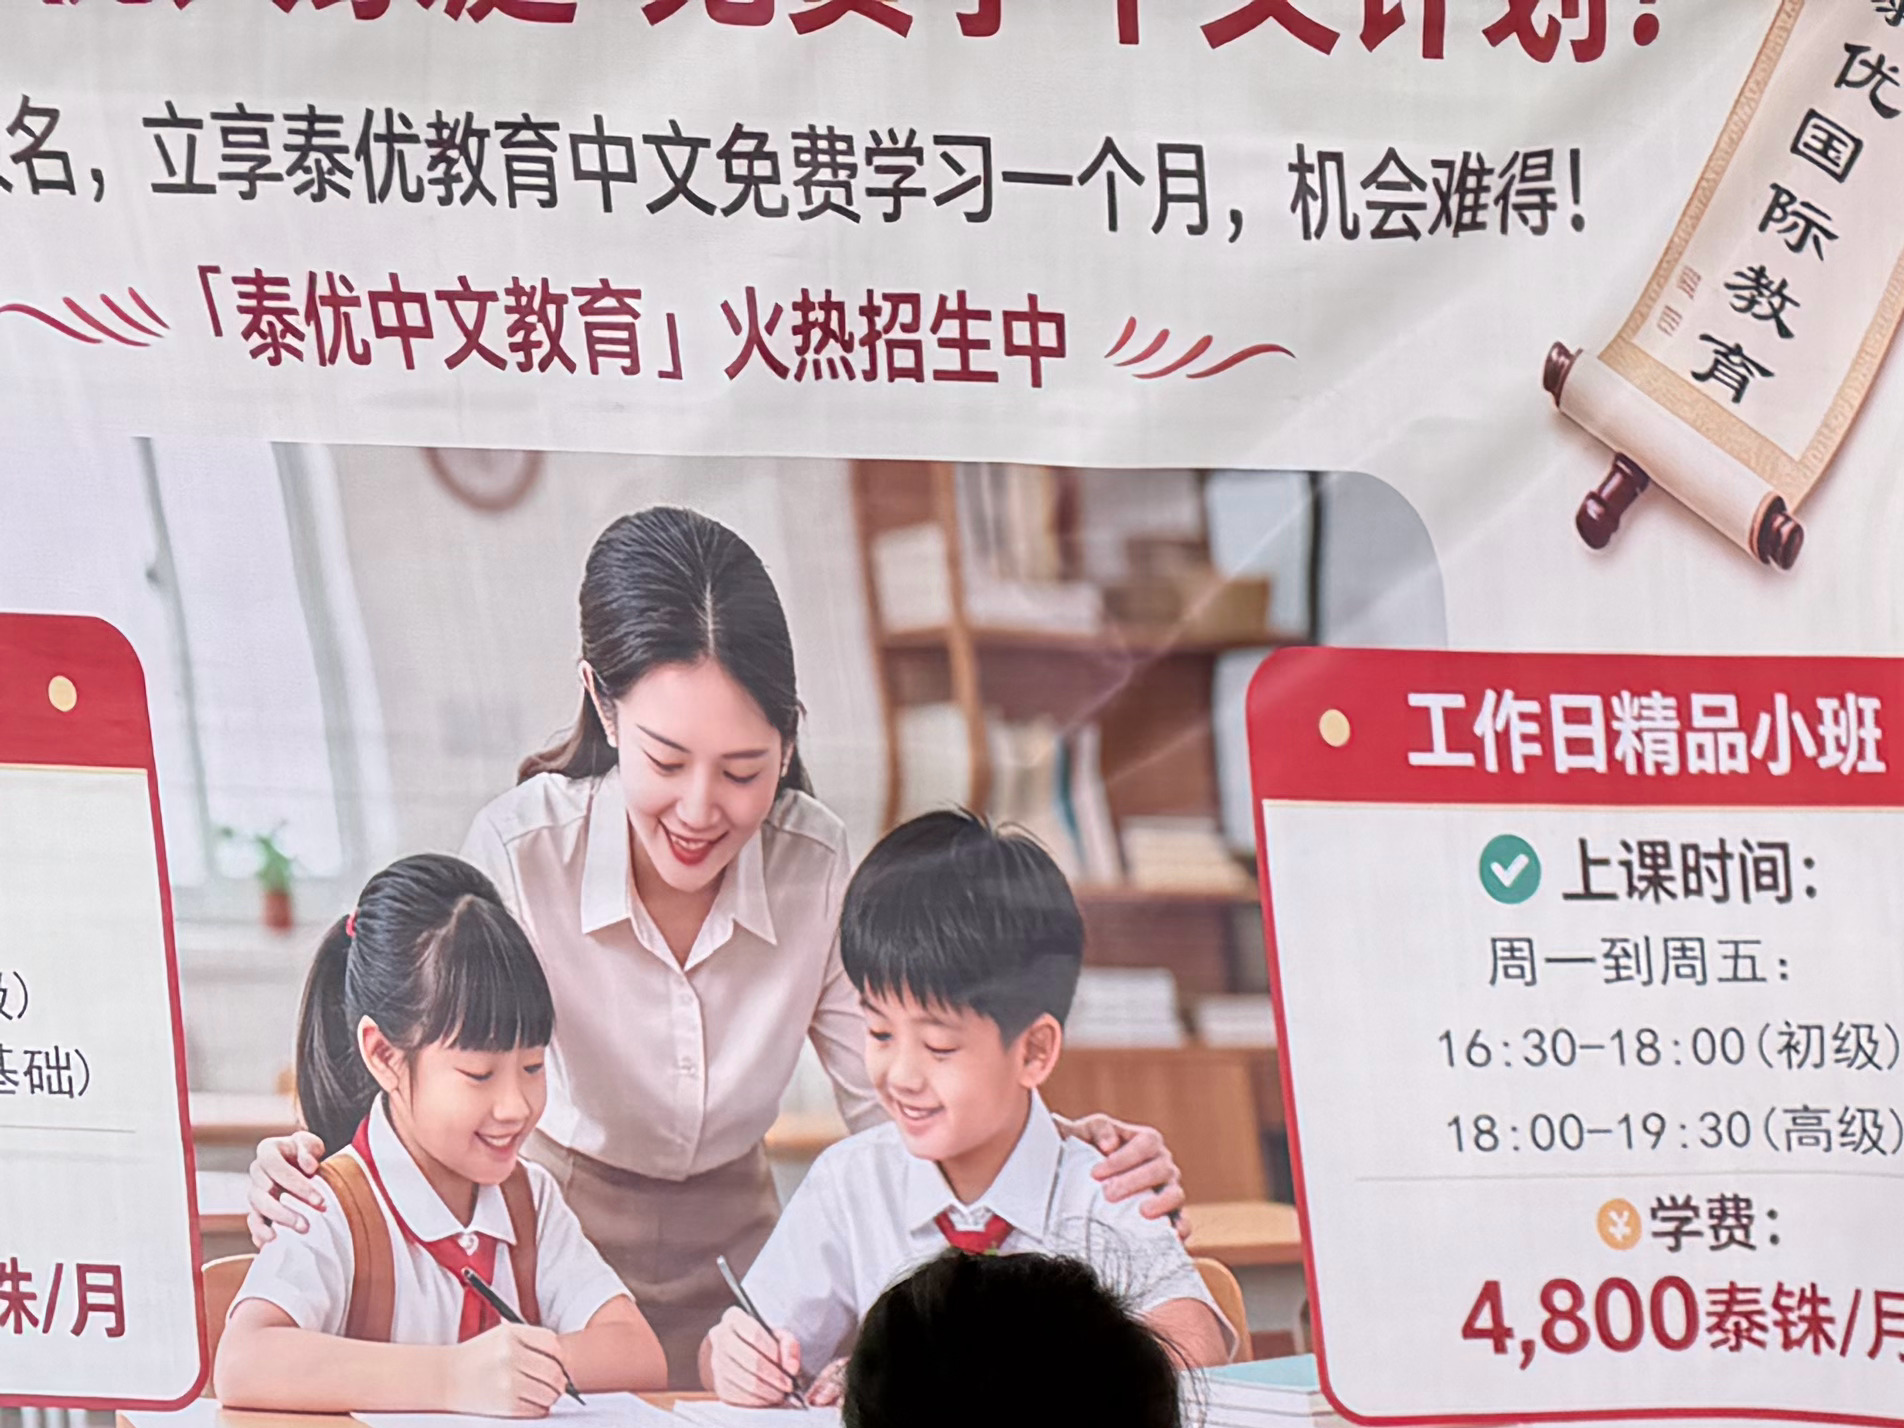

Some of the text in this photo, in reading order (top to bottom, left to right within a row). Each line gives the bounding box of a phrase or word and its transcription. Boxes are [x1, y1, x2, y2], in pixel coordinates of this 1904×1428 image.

[0, 94, 1587, 243] 名，立享泰优教育中文免费学习一个月，机会难得！
[1406, 690, 1887, 776] 工作日精品小班
[1561, 838, 1819, 905] 上课时间：
[1488, 936, 1791, 988] 周一到周五：
[1649, 1194, 1781, 1252] 学费：
